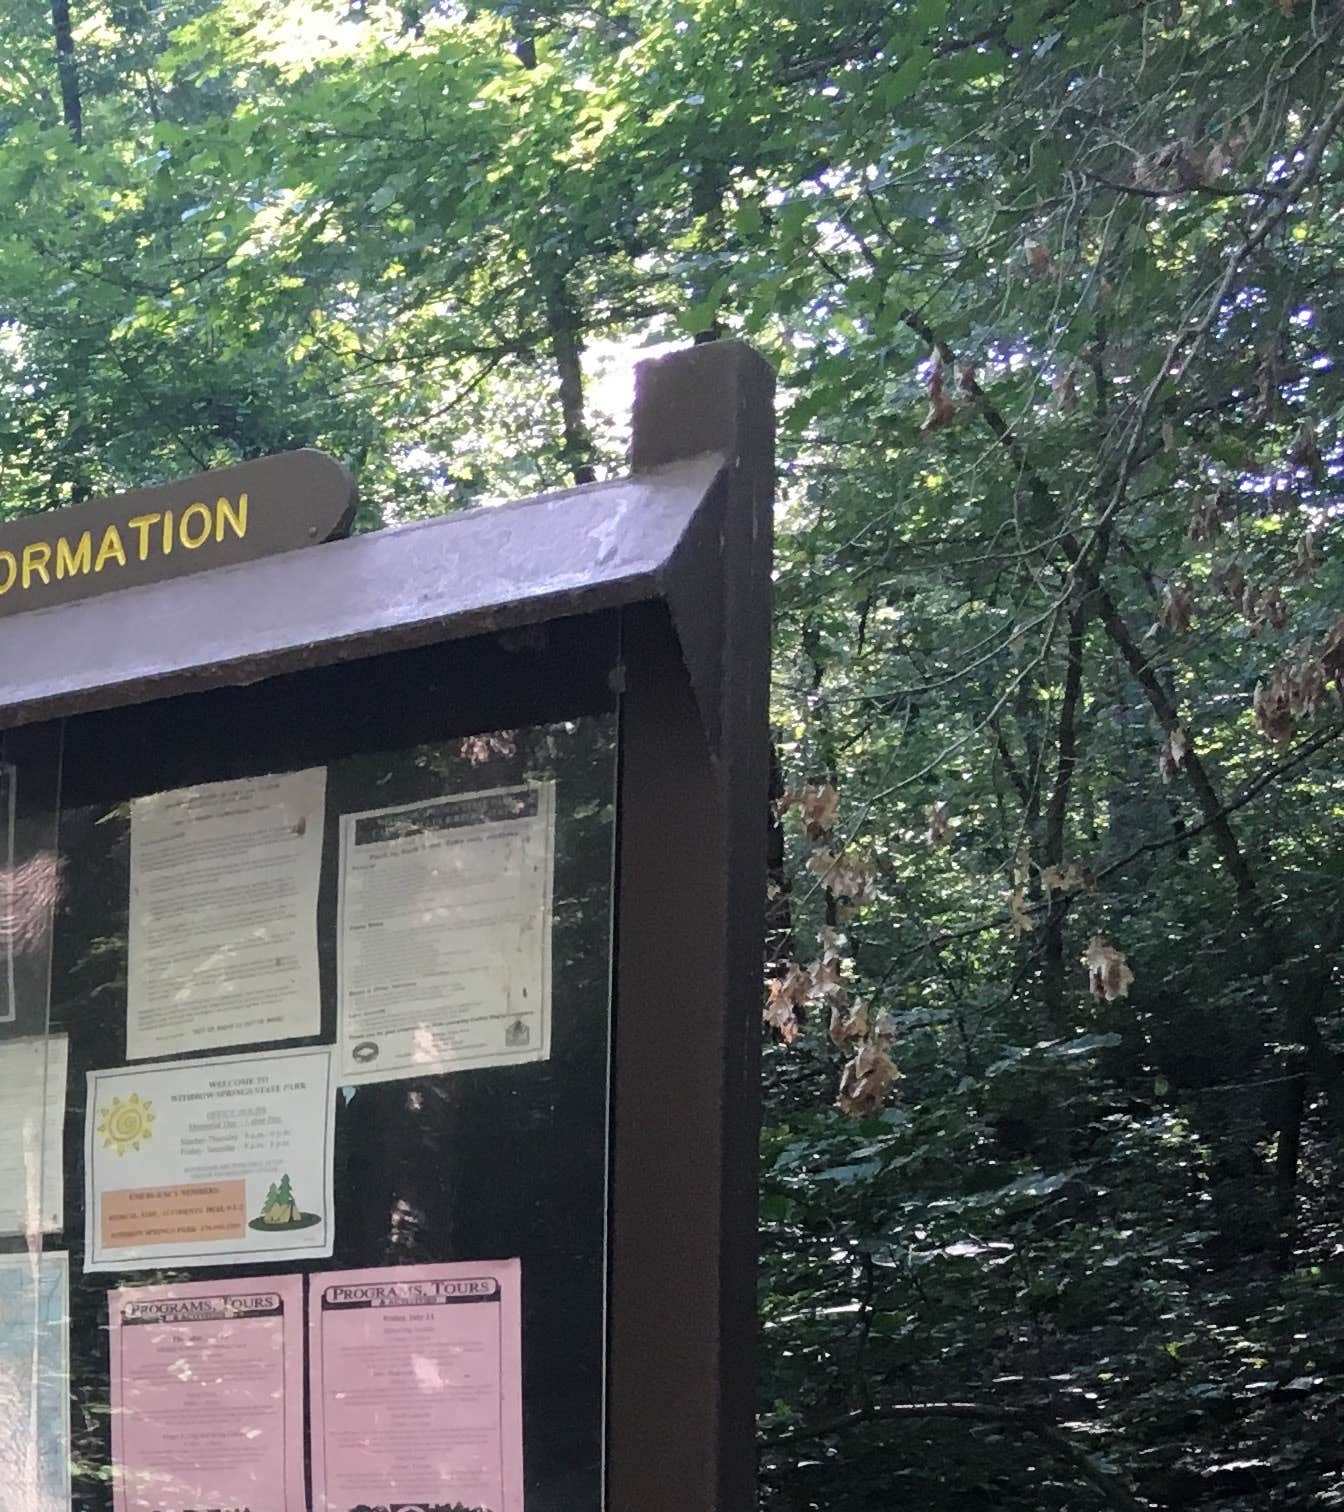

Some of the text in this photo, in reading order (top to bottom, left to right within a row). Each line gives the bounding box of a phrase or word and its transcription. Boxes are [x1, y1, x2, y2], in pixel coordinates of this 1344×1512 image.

[208, 1076, 270, 1089] WELCOME TO
[283, 1081, 307, 1092] PARK
[332, 1280, 490, 1301] PROGRAMS, TOURS
[132, 1295, 274, 1316] PROGRAMS, TOURS
